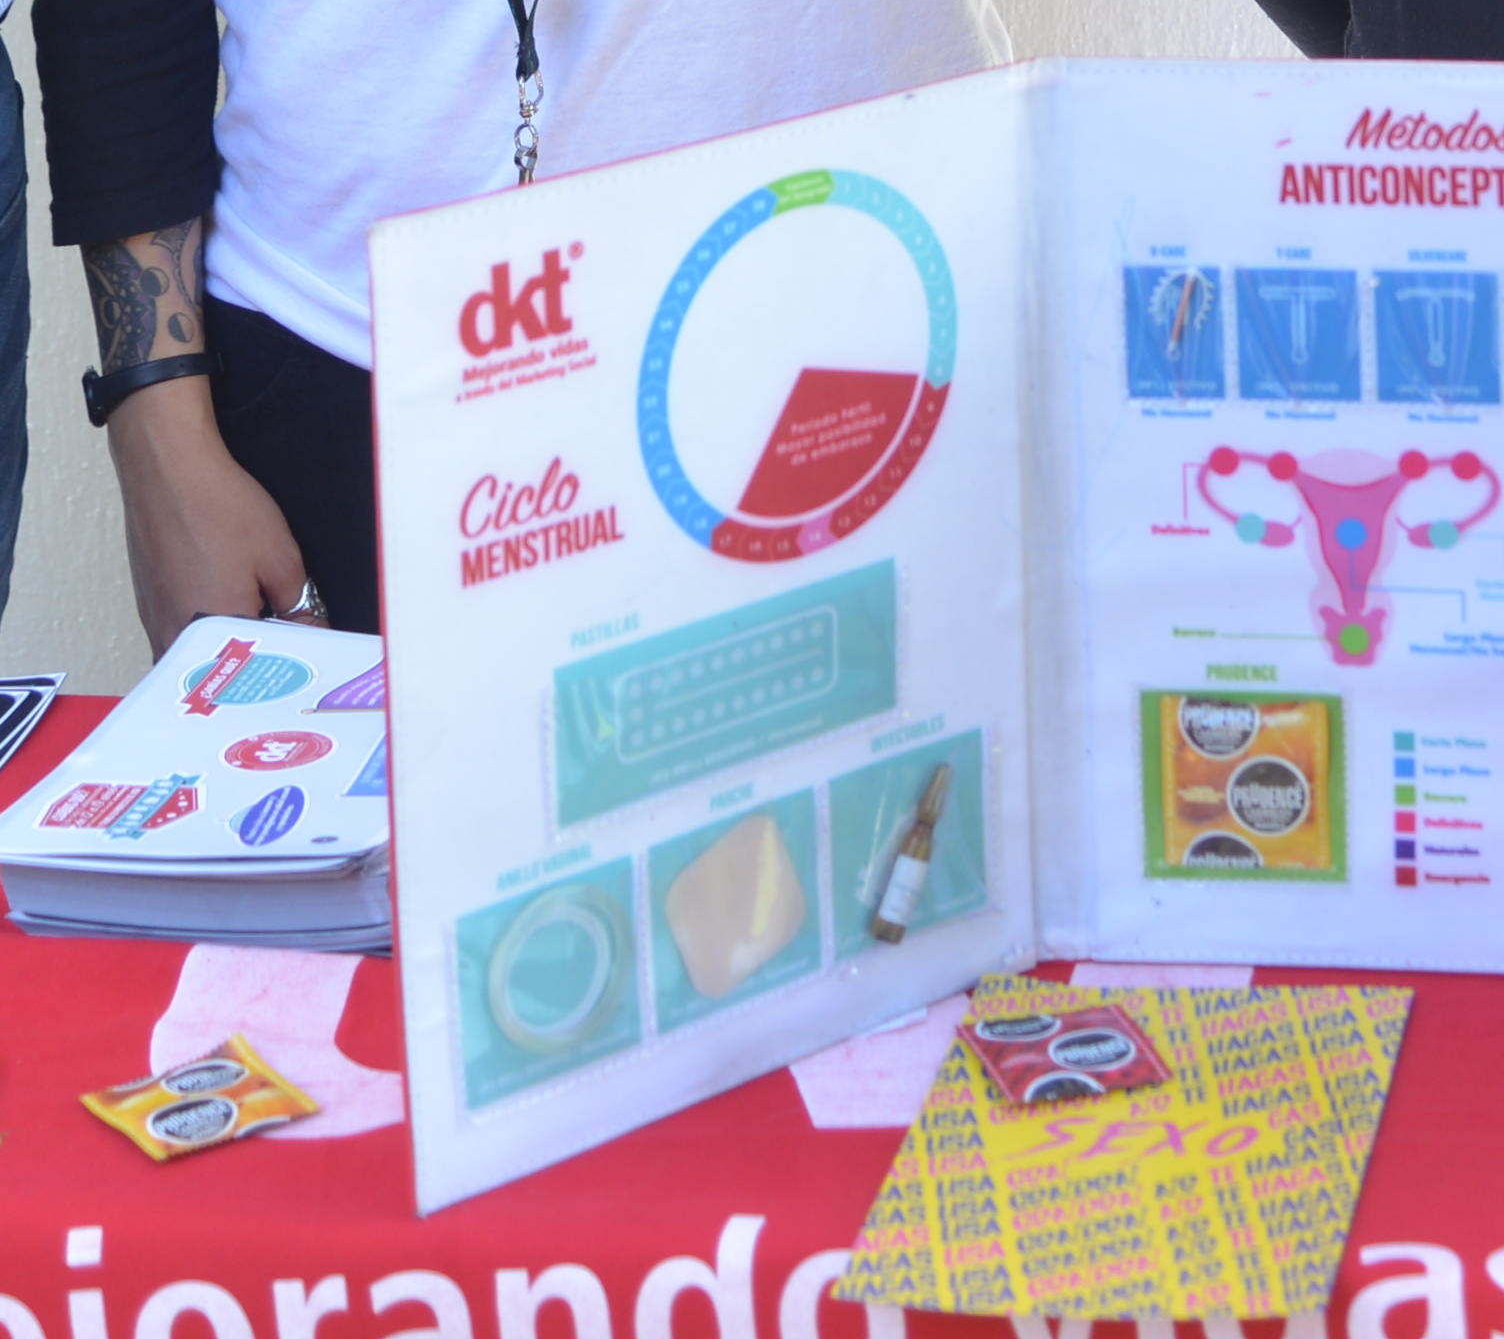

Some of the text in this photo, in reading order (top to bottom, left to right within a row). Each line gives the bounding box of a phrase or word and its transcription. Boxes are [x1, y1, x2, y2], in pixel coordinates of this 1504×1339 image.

[463, 337, 588, 384] Mejorando vidas
[460, 456, 580, 539] Ciclo
[460, 504, 625, 589] MENSTRUAL
[571, 611, 640, 651] PASTILLAS
[1207, 664, 1278, 682] PRUDENCE
[999, 1112, 1260, 1161] SEXO
